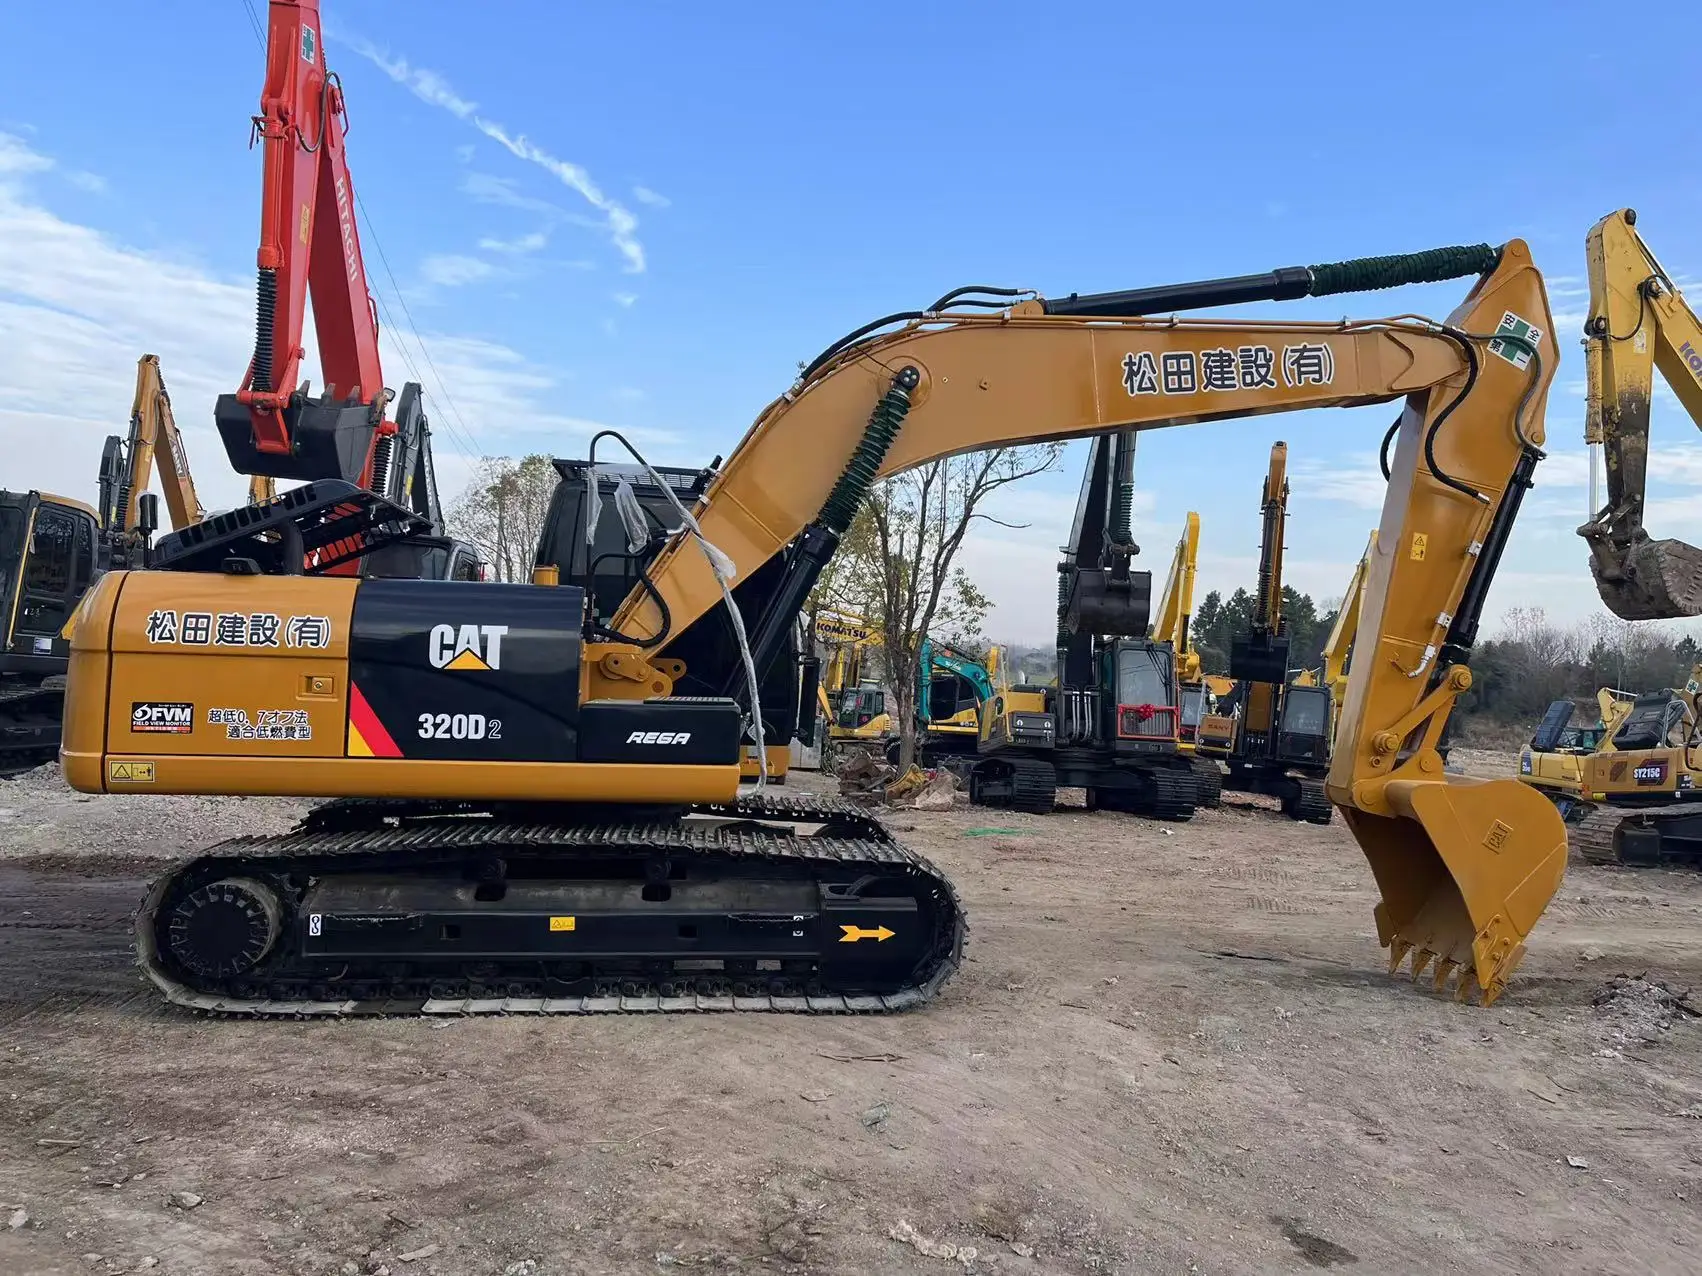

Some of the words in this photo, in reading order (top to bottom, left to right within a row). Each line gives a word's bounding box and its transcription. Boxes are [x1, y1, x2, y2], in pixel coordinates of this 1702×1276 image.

[336, 176, 358, 282] HITACHI
[1122, 343, 1334, 396] 松田建設(有)
[1679, 341, 1702, 377] KO
[146, 610, 331, 648] 松田建設(有)
[816, 622, 867, 639] KOMATSU
[429, 624, 508, 670] CAT
[151, 707, 191, 721] FVM
[227, 725, 311, 739] 適合低燃費型
[625, 731, 691, 745] REGA
[1632, 767, 1661, 779] SY215C
[1487, 822, 1509, 849] CAT
